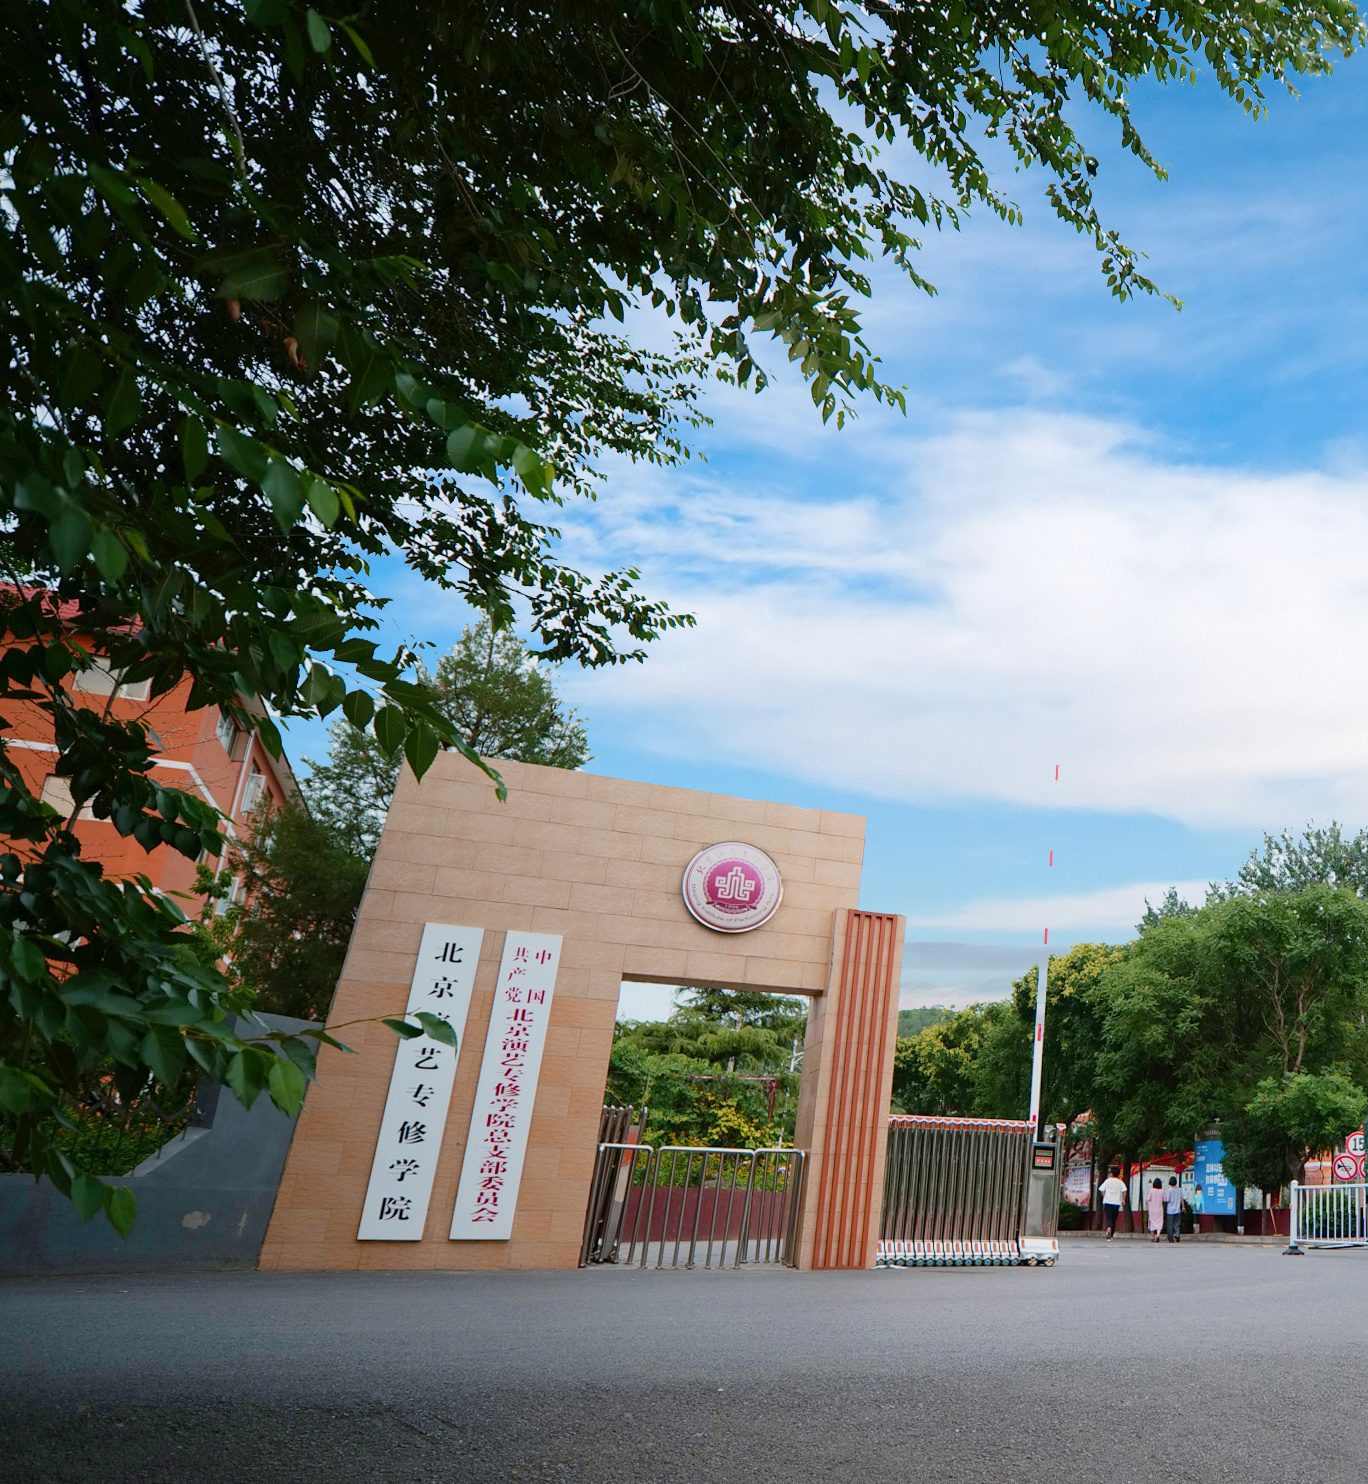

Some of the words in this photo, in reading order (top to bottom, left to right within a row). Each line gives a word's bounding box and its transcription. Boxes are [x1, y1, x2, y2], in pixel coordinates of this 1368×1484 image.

[504, 946, 530, 1004] 共产党
[526, 949, 552, 1005] 中国
[378, 942, 464, 1221] 北京艺专修学院
[470, 1008, 534, 1223] 北京演艺专修学院总支部委员会
